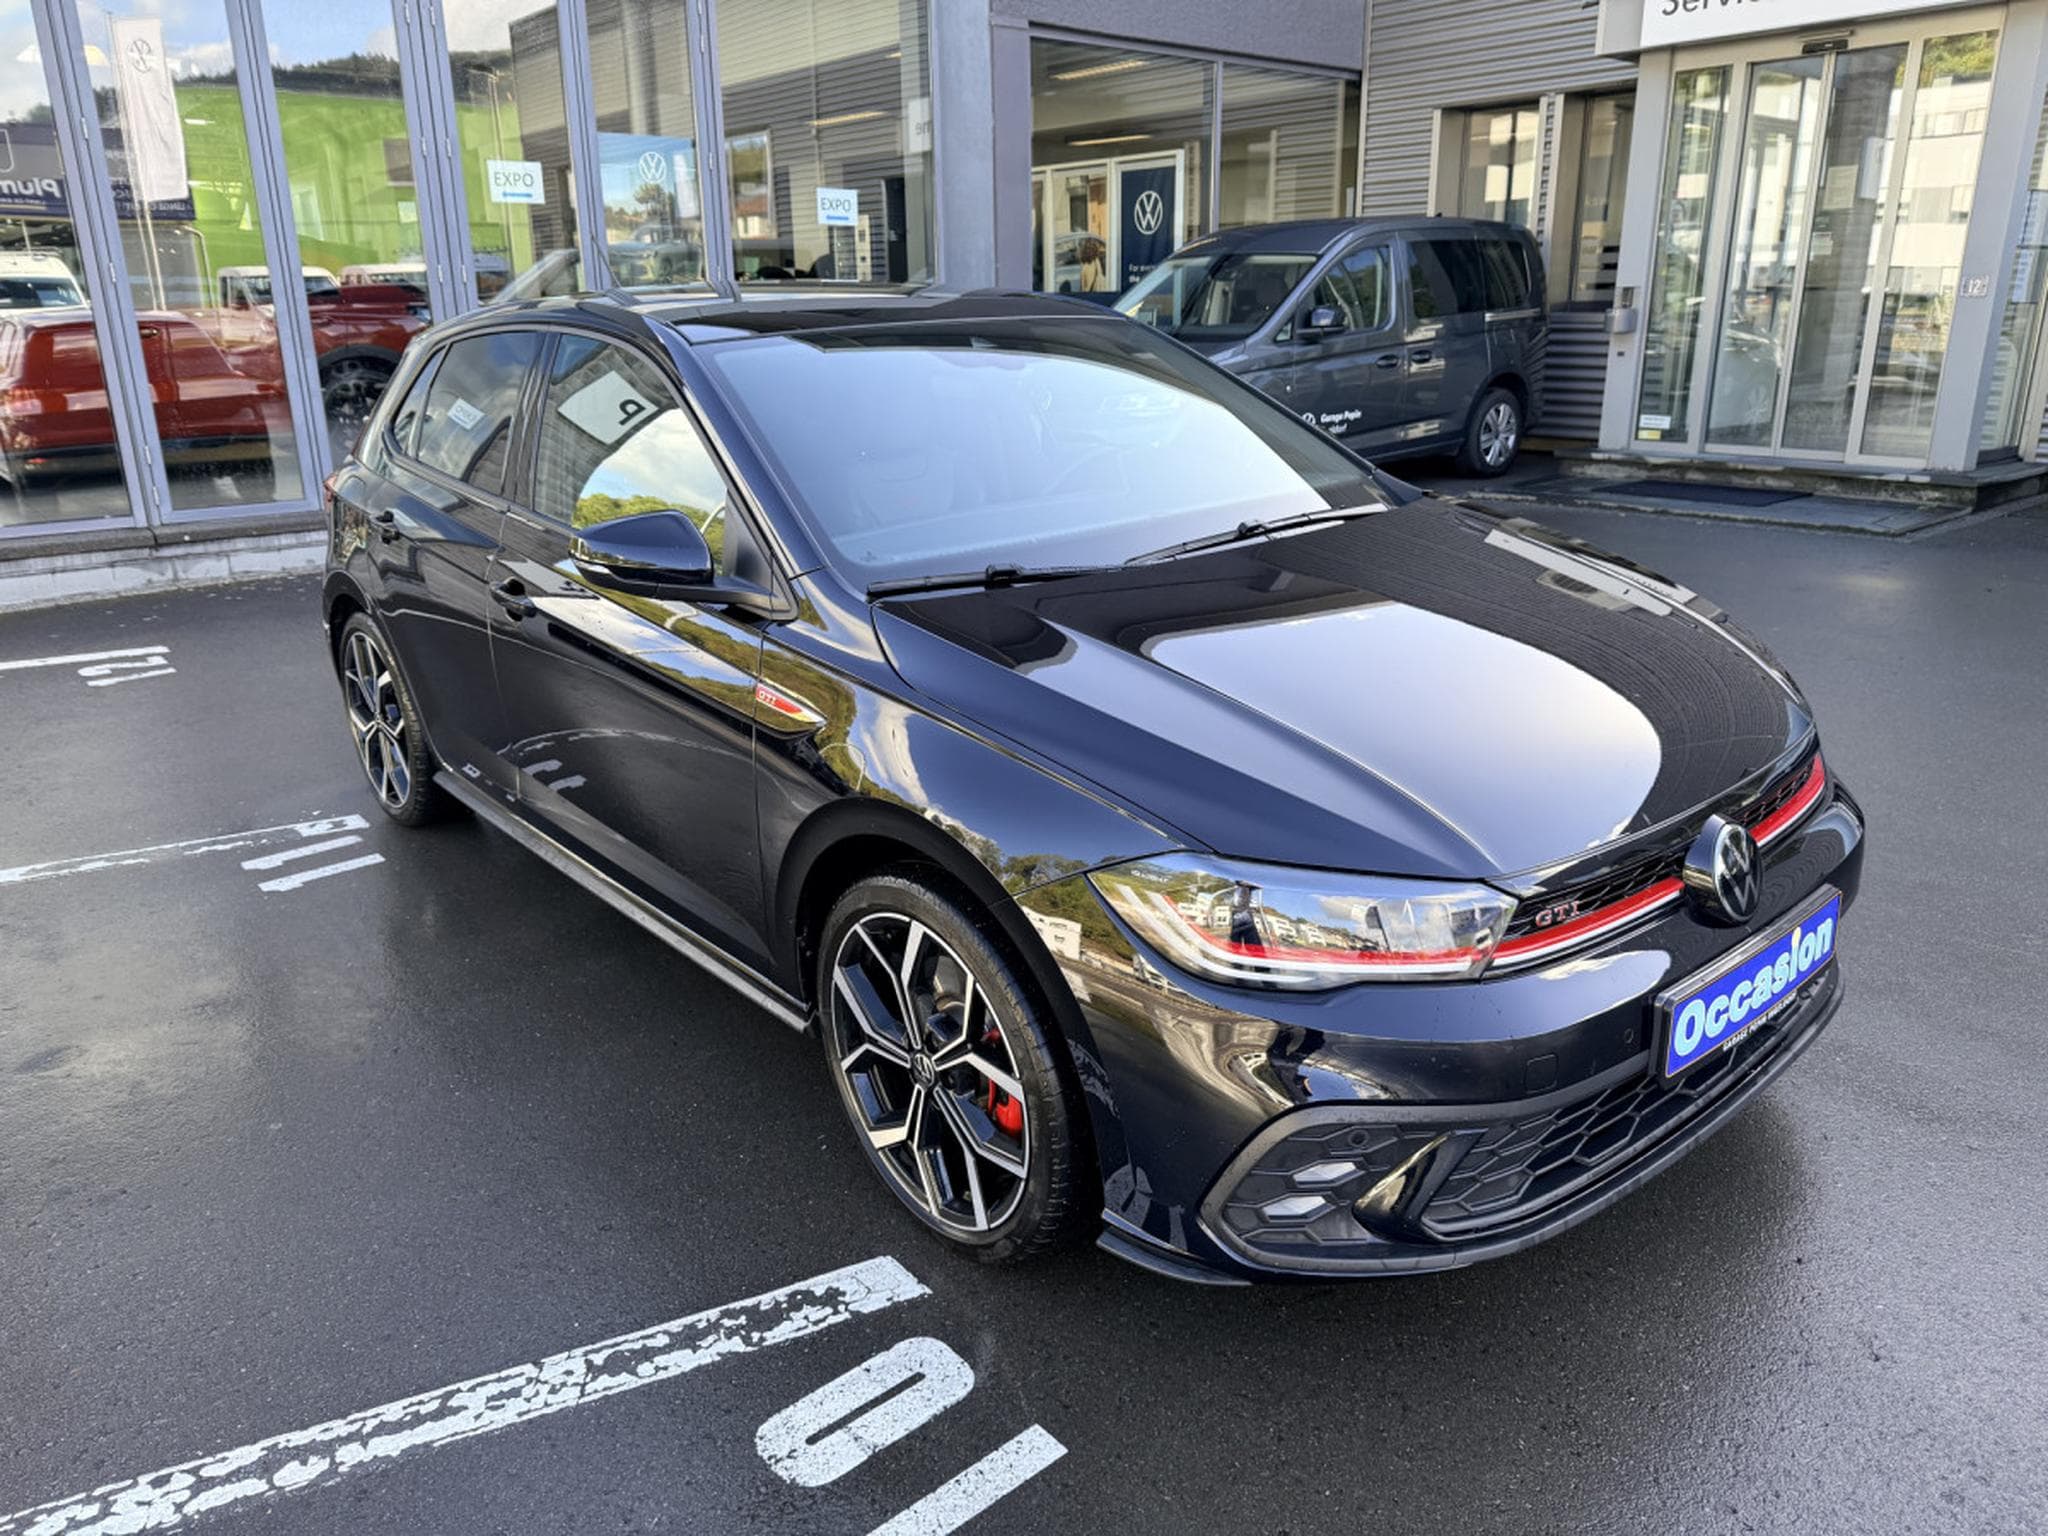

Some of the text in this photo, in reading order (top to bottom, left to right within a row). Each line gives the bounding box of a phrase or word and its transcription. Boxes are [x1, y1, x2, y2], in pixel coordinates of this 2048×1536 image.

[494, 171, 534, 188] EXPO
[820, 197, 852, 212] EXPO
[1535, 900, 1580, 927] GTI
